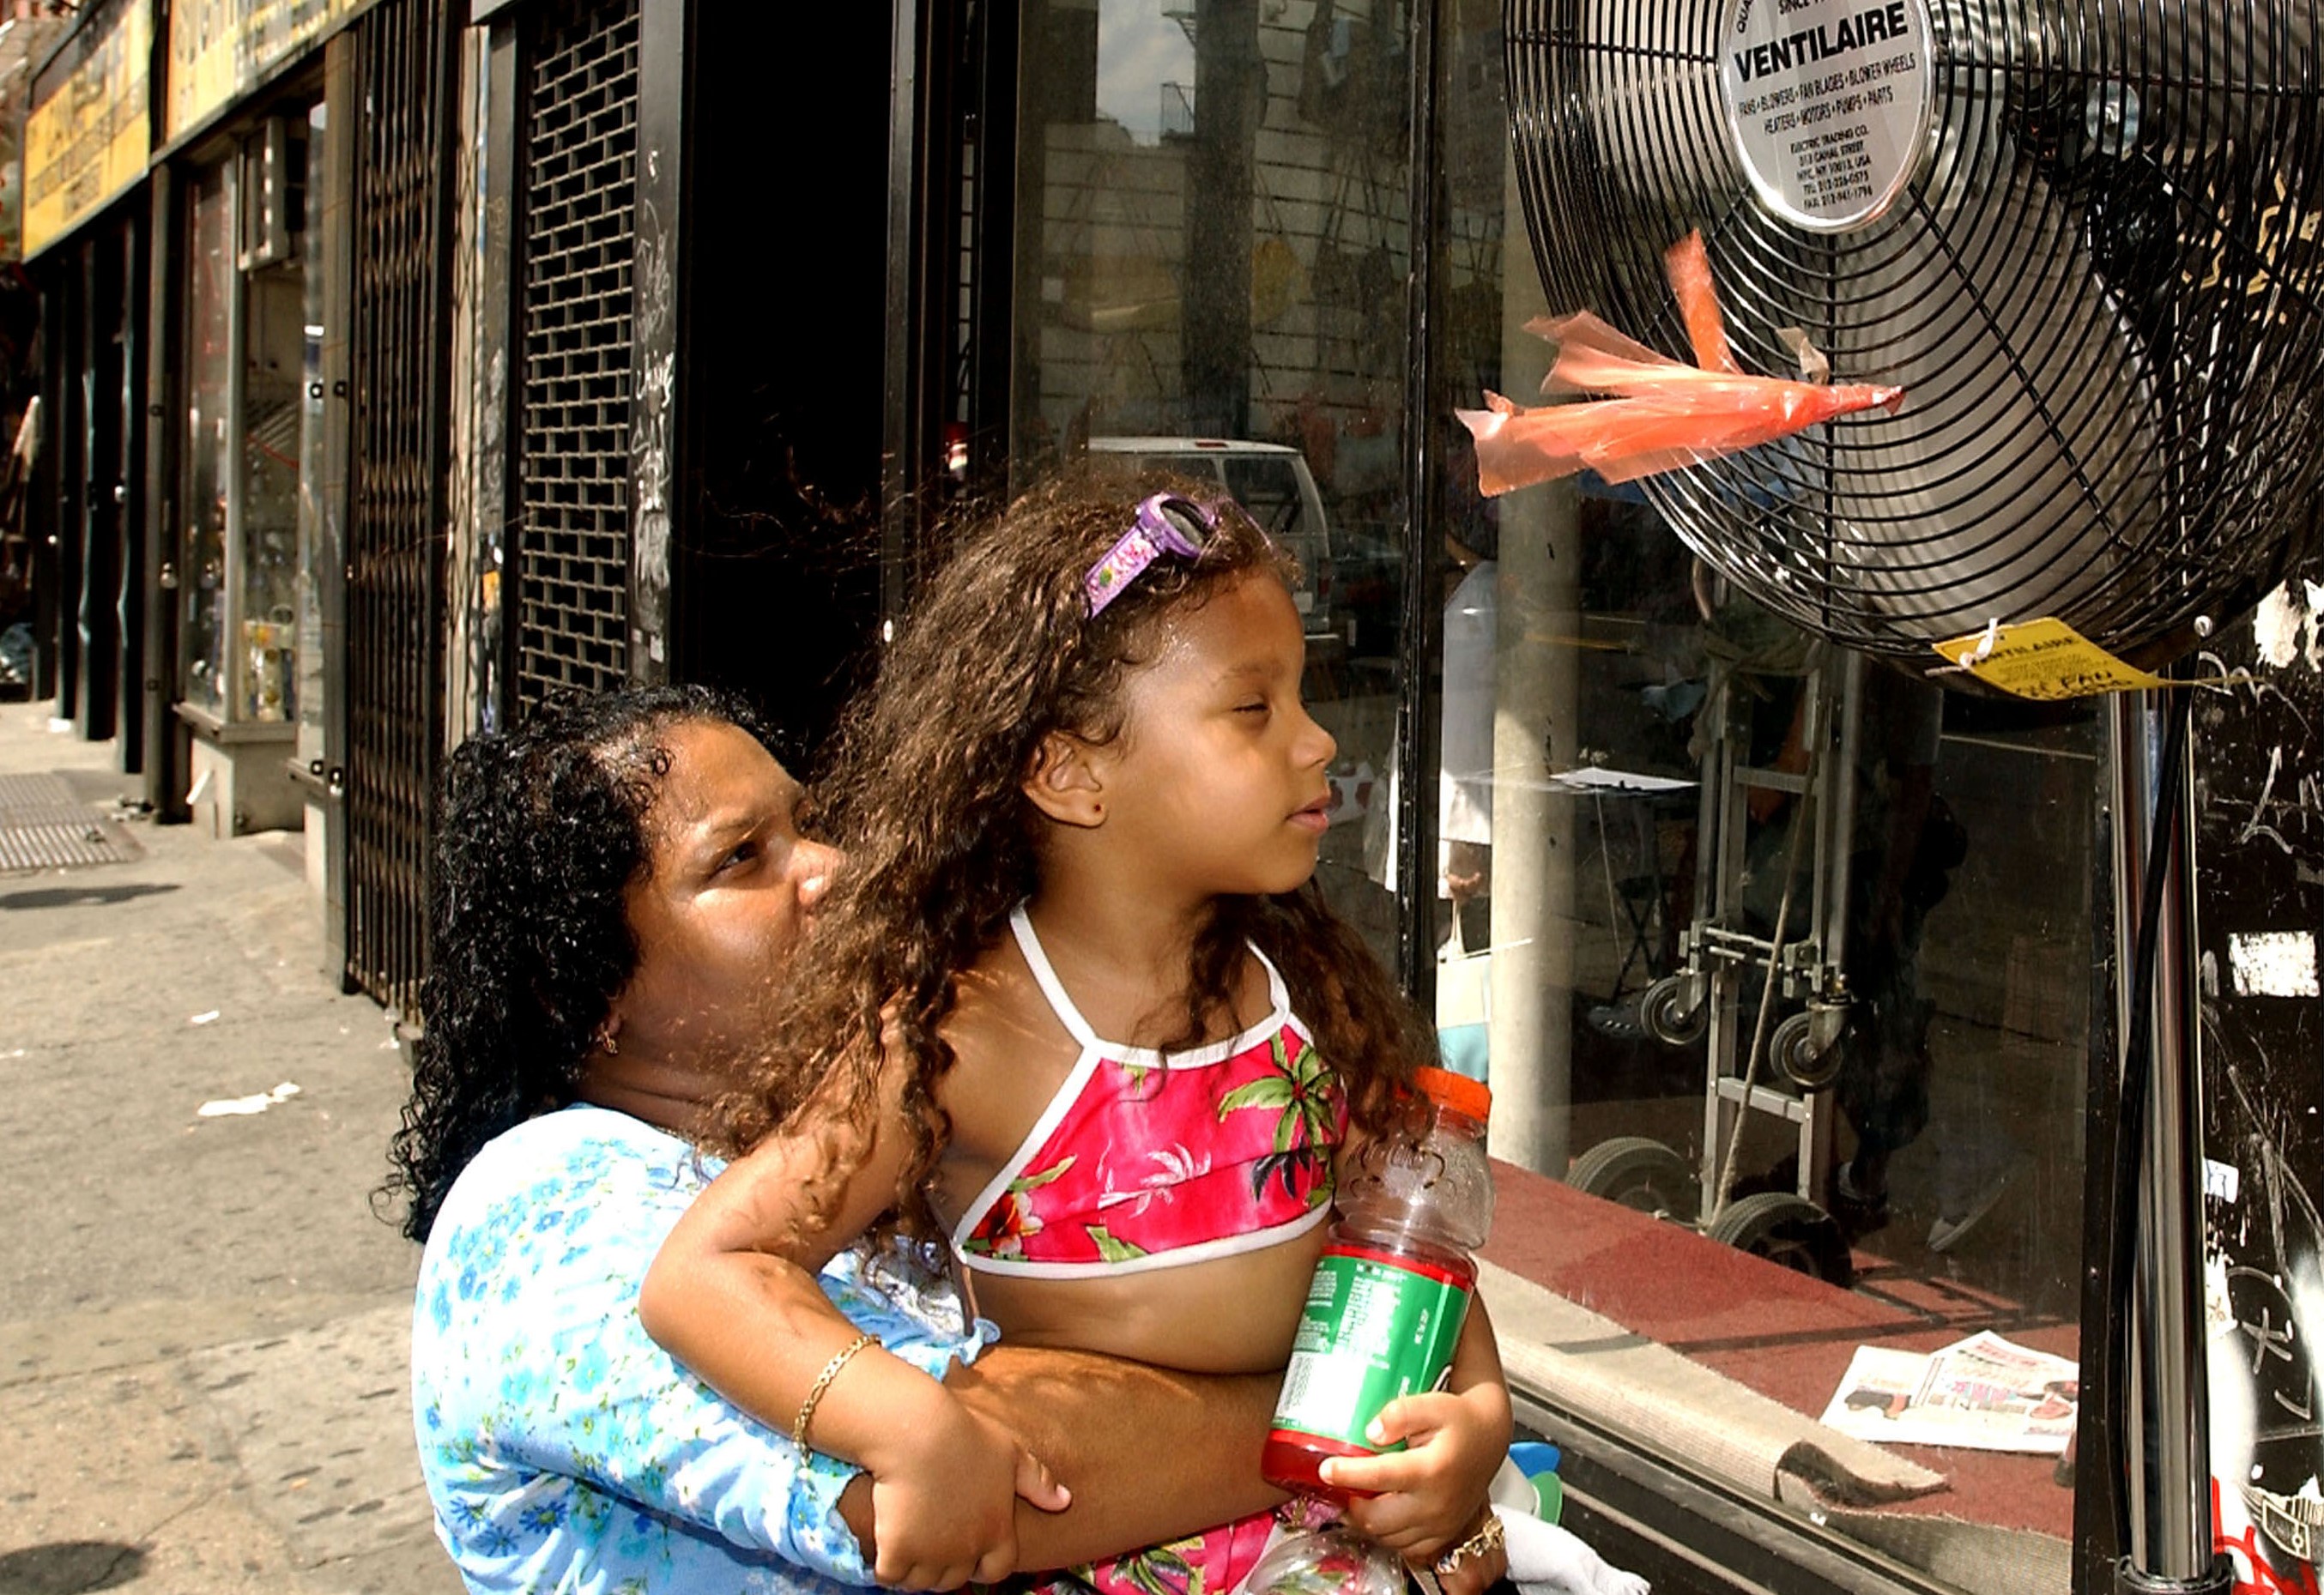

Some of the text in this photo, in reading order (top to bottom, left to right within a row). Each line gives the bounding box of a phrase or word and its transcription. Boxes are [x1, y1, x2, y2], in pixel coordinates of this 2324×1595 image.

[1734, 2, 1909, 83] VENTILAIRE
[1739, 52, 1915, 118] FANS BLOWERS FAN BLADES BLOWER WHEELS
[1764, 85, 1894, 134] HEATERS MOTORS PUMPS PARTS
[1790, 136, 1820, 154] ELECTRIC
[1821, 128, 1854, 145] TRADING
[1813, 147, 1839, 162] CANAL
[1841, 140, 1863, 155] STREET
[1855, 154, 1871, 167] USA
[1972, 637, 2079, 666] NTILAIRE
